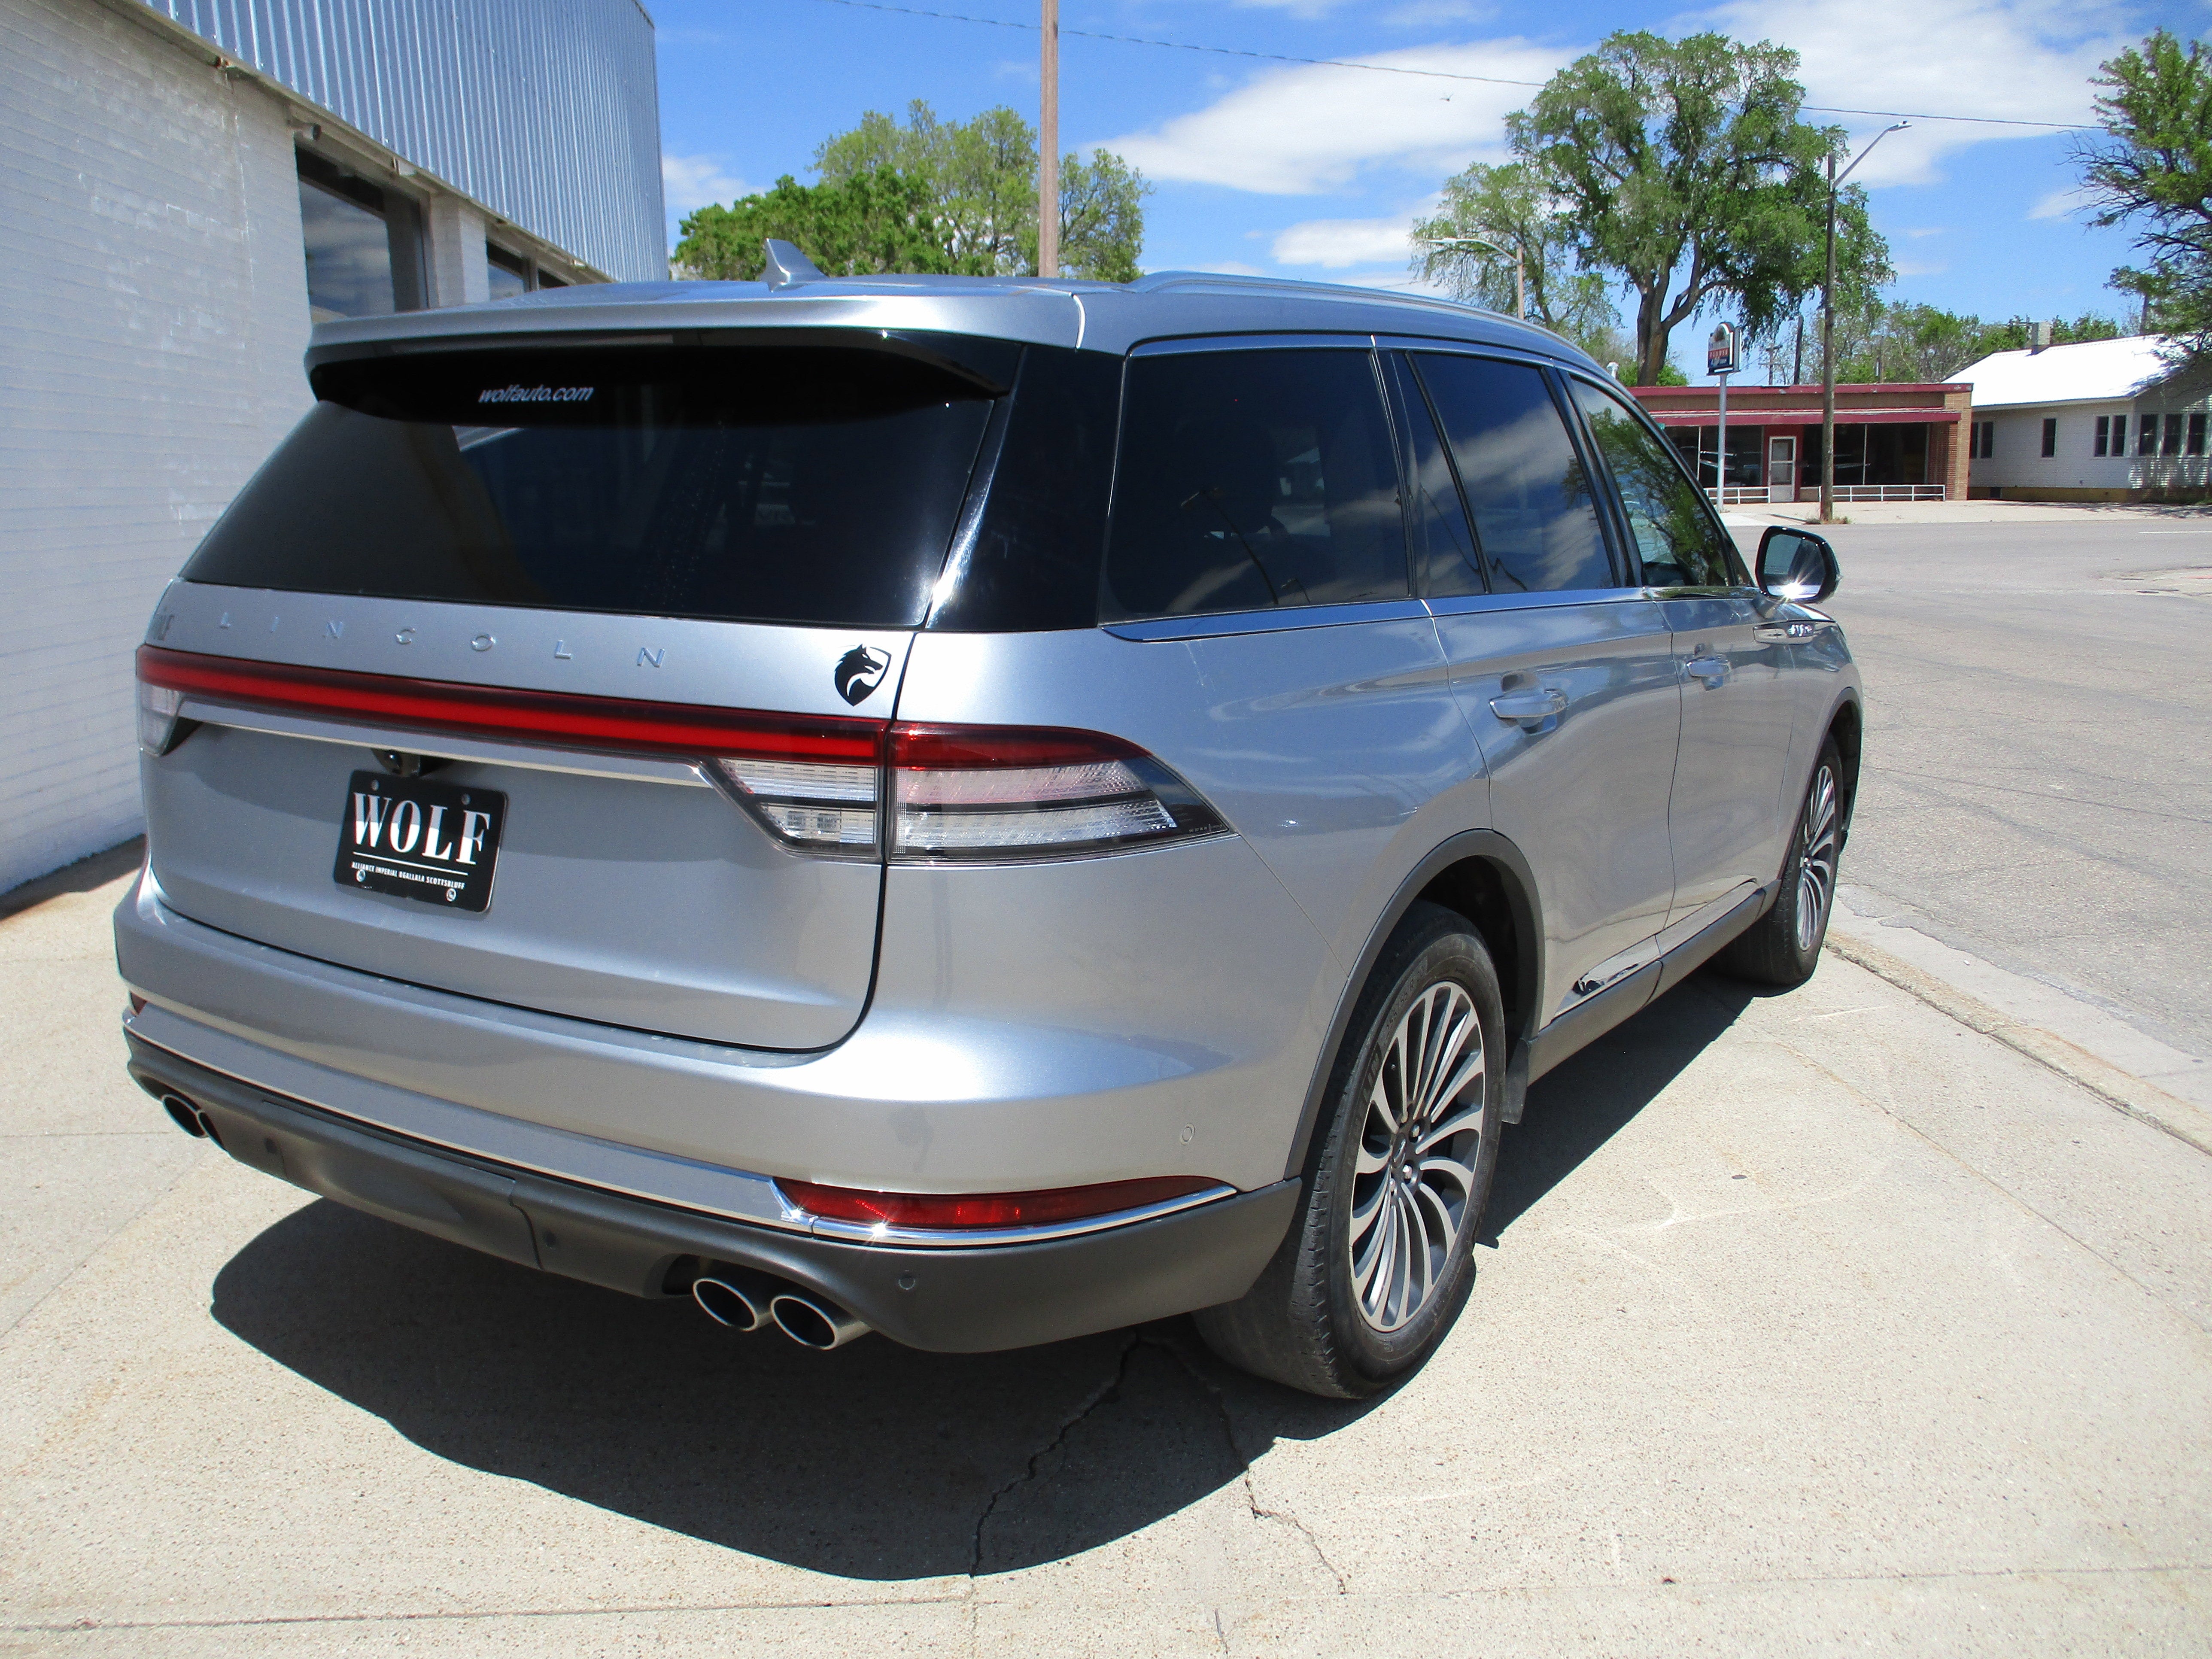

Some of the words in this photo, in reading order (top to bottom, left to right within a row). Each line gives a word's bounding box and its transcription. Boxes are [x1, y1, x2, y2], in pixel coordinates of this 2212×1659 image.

[478, 384, 595, 403] wolfauto.com
[219, 611, 666, 668] LINCOLN
[353, 792, 491, 865] WOLF
[351, 861, 375, 873] ALLIANCE
[375, 866, 398, 877] IMPERIAL
[399, 871, 425, 882] OGALLALA
[426, 876, 465, 890] SCOTTSBLUFF
